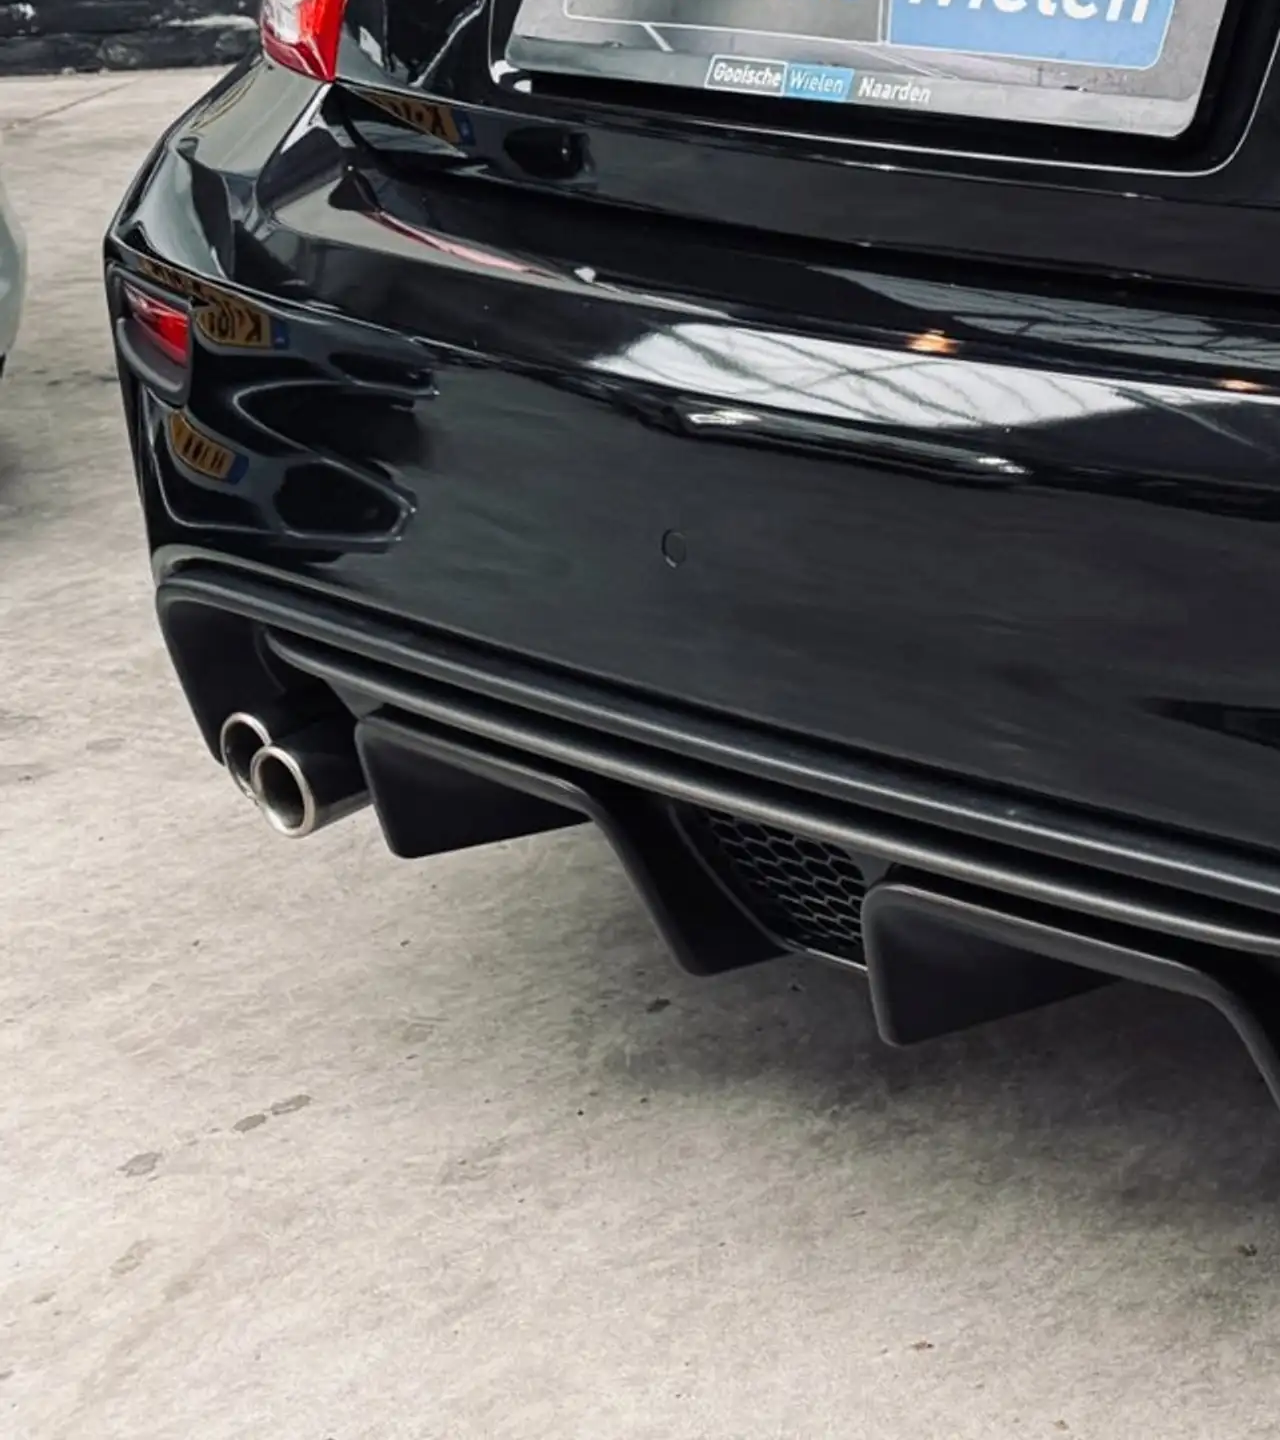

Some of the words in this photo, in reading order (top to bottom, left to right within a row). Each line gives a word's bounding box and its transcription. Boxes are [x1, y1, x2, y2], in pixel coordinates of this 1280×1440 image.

[713, 62, 782, 88] Gooische
[789, 69, 844, 93] Wielen
[858, 76, 932, 104] Naarden
